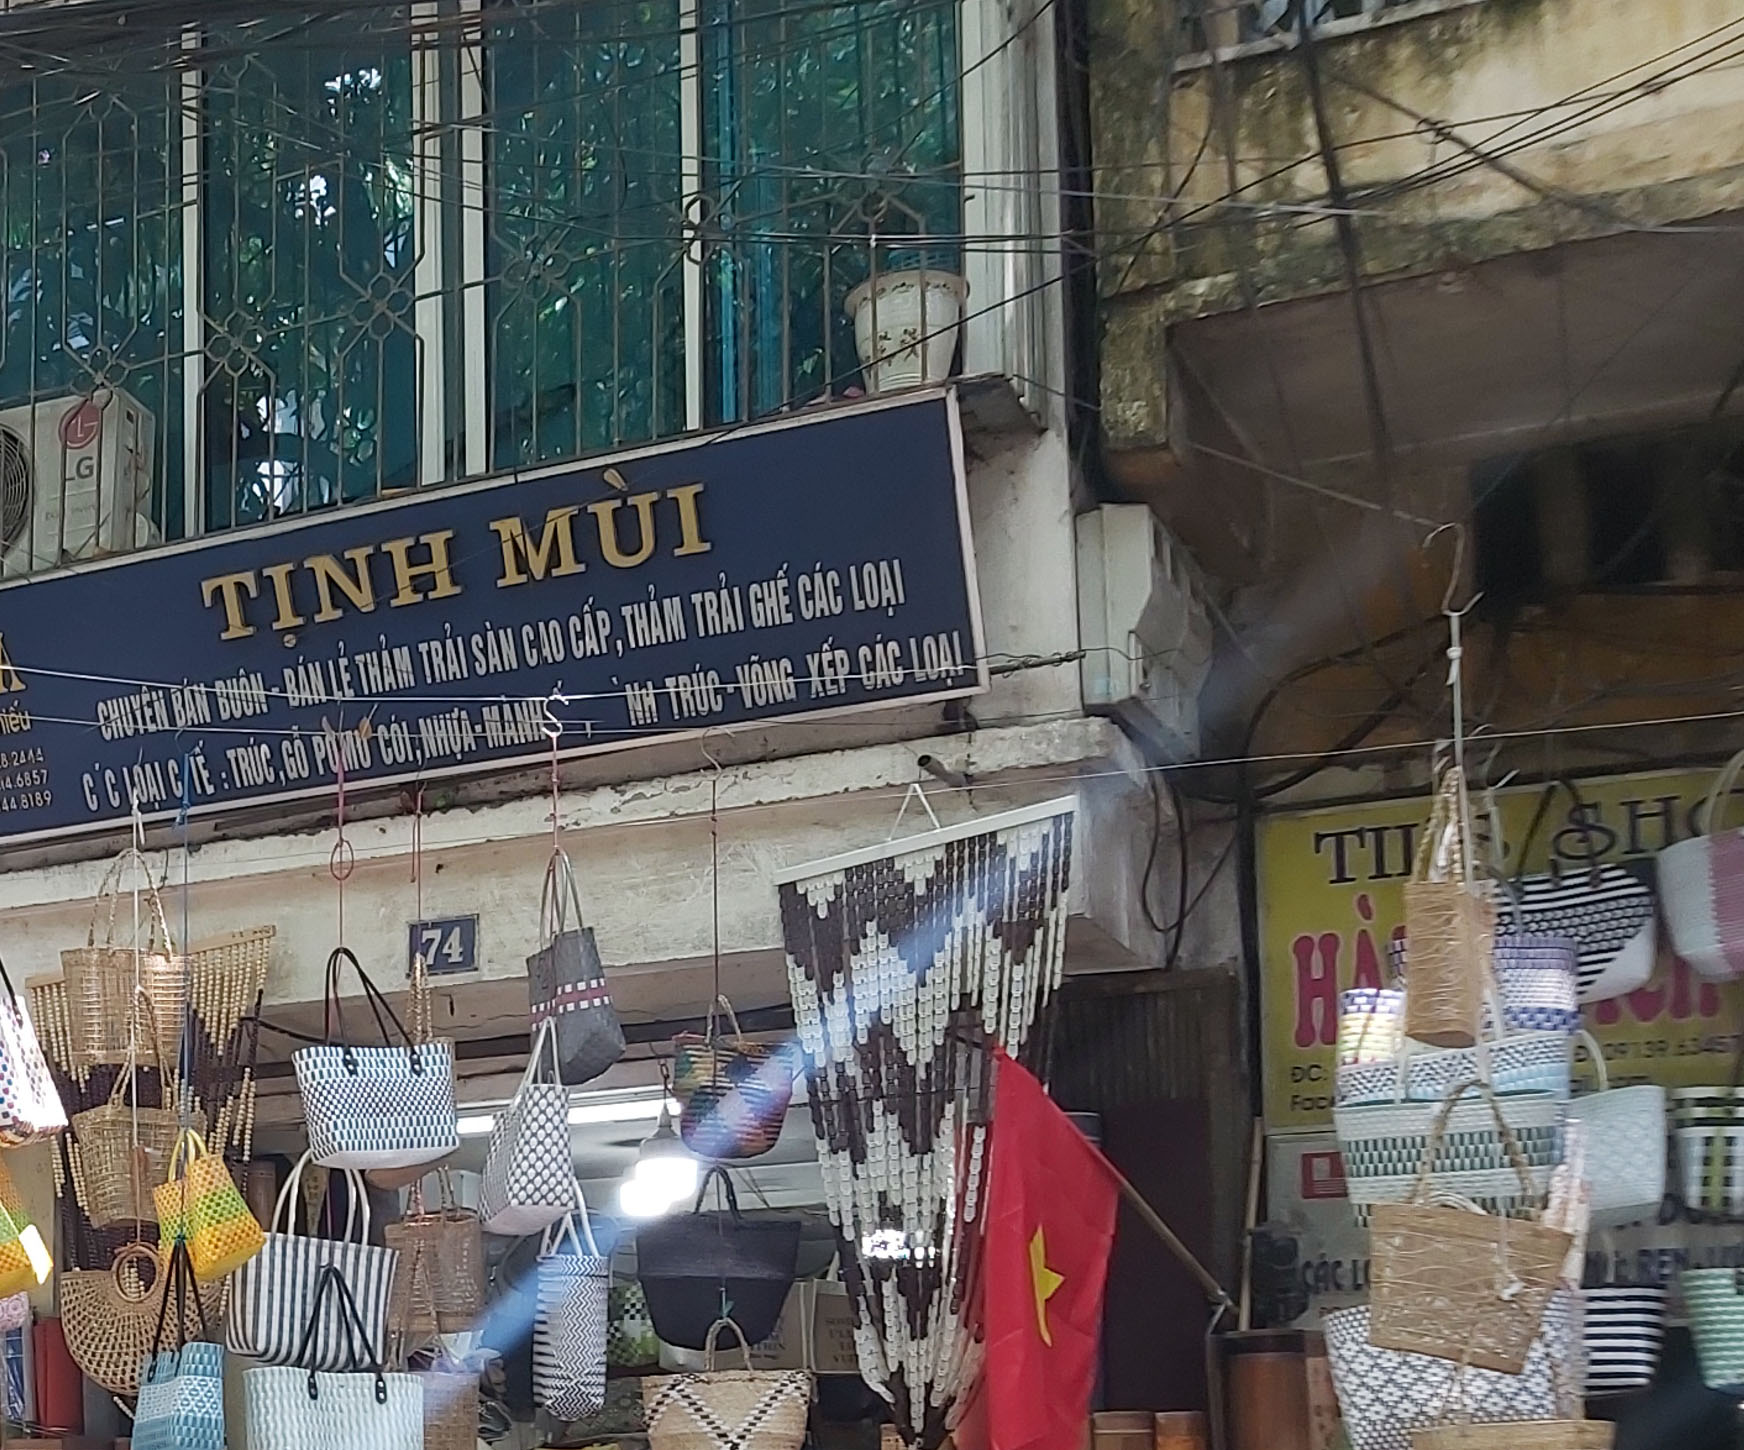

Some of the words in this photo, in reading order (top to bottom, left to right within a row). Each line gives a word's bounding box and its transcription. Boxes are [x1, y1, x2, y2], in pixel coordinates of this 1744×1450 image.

[201, 529, 462, 647] TỊNH
[489, 467, 712, 588] MÙI
[97, 686, 170, 741] CHUYÊN
[171, 678, 211, 728] BÁN
[214, 668, 269, 721] BUÔN
[283, 656, 327, 708] BÁN
[328, 641, 355, 701] LẺ
[355, 634, 416, 695] THẢM
[418, 622, 469, 685] TRẢI
[471, 621, 519, 676] SÀN
[521, 618, 566, 668] CAO
[691, 572, 746, 638] TRẢI
[748, 562, 794, 630] GHẾ
[797, 561, 844, 621] CÁC
[848, 558, 906, 617] LOẠI
[806, 636, 851, 698] XẾP
[859, 633, 906, 691] CÁC
[909, 630, 965, 687] LOẠI
[421, 926, 464, 966] 74
